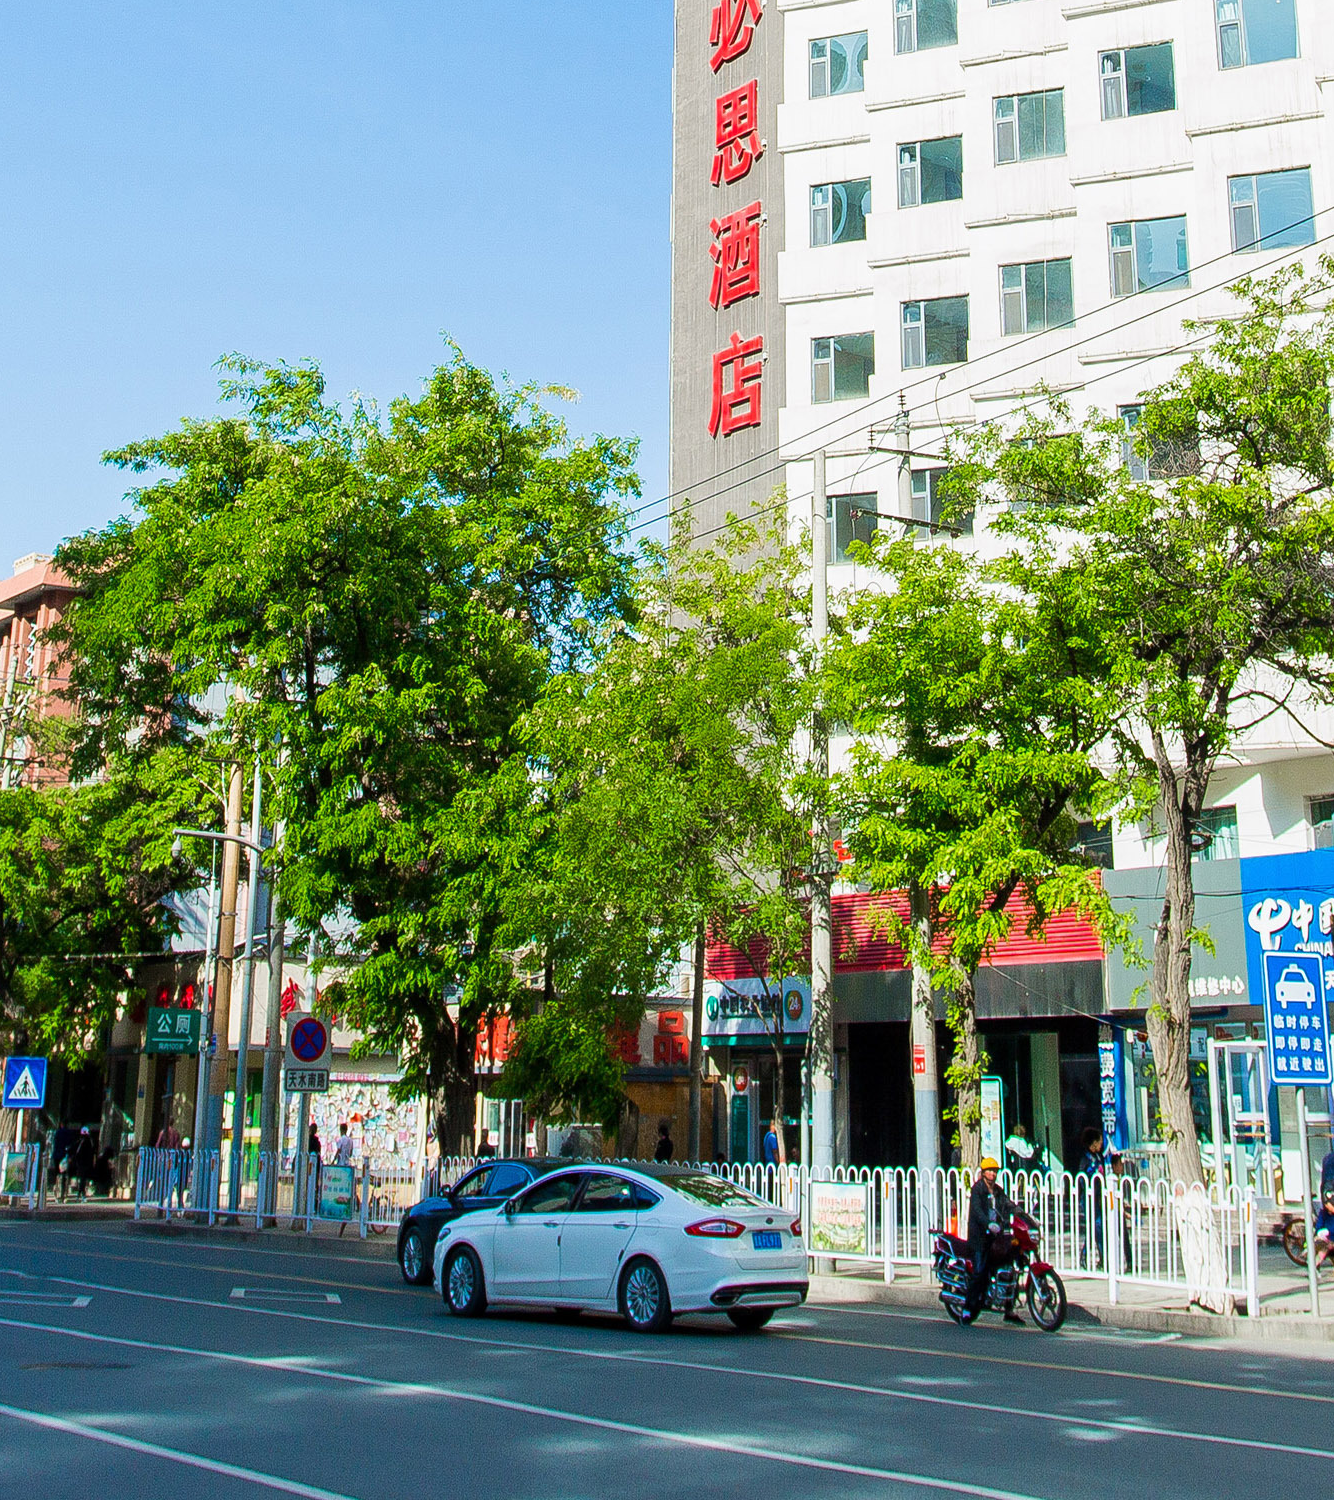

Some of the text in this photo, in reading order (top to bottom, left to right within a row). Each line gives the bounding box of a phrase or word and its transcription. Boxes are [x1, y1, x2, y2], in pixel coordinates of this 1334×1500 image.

[157, 1013, 191, 1034] 公厕
[1273, 1014, 1322, 1030] 临时停车
[1274, 1035, 1324, 1052] 即停即走
[1276, 1056, 1326, 1073] 就近驶出
[288, 1072, 326, 1089] 天水南路
